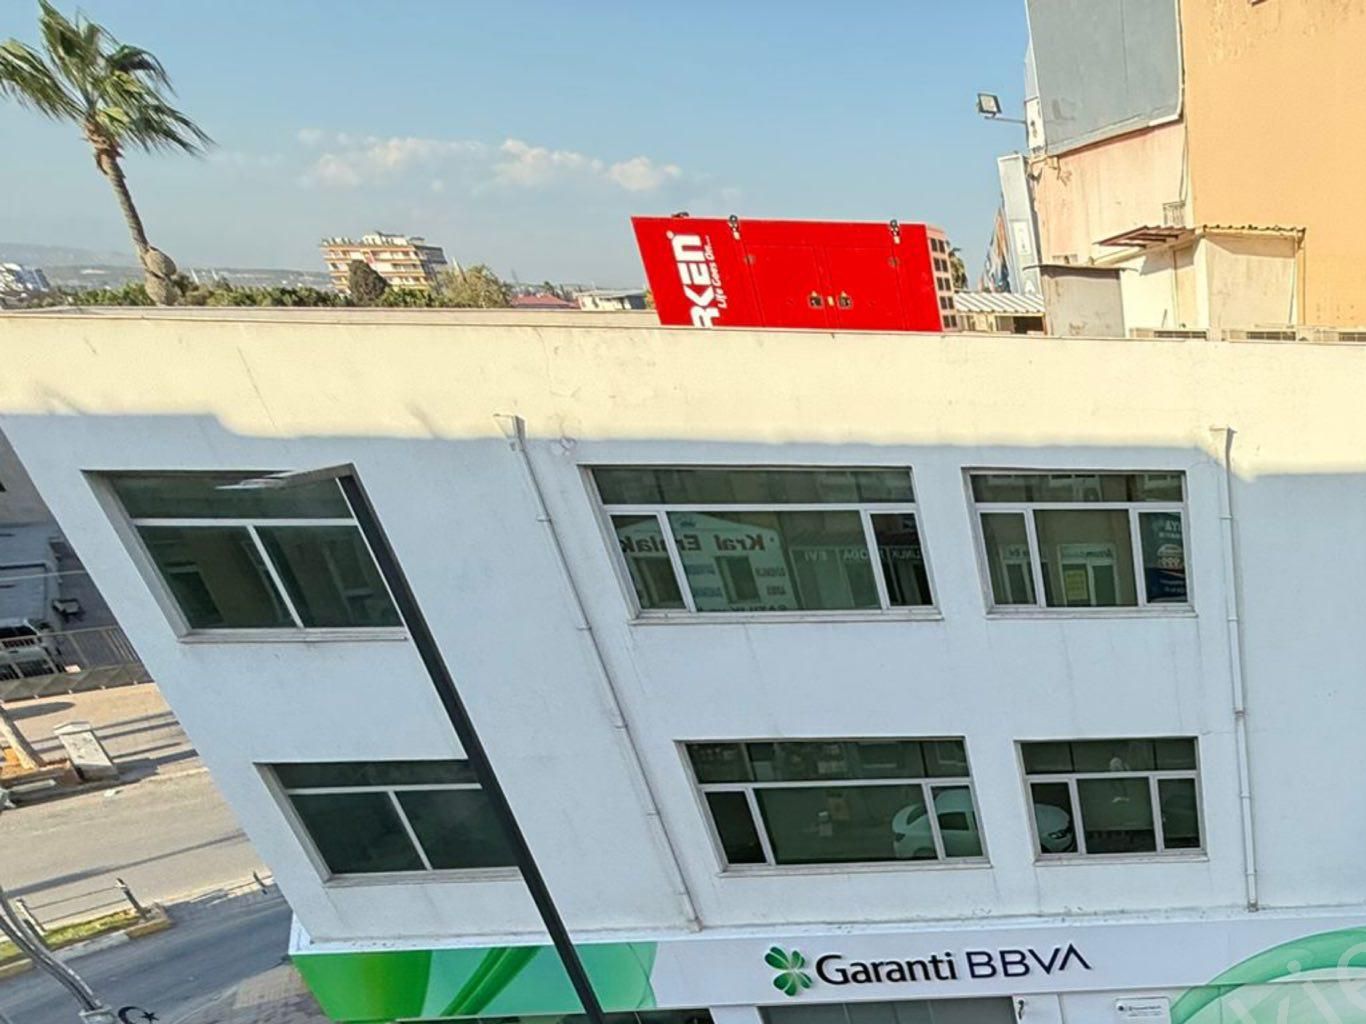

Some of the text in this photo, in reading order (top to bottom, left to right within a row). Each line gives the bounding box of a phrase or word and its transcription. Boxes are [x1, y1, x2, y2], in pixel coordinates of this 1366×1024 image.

[709, 262, 722, 287] Goes
[715, 287, 728, 309] Life
[815, 943, 1092, 985] Garanti BBVA
